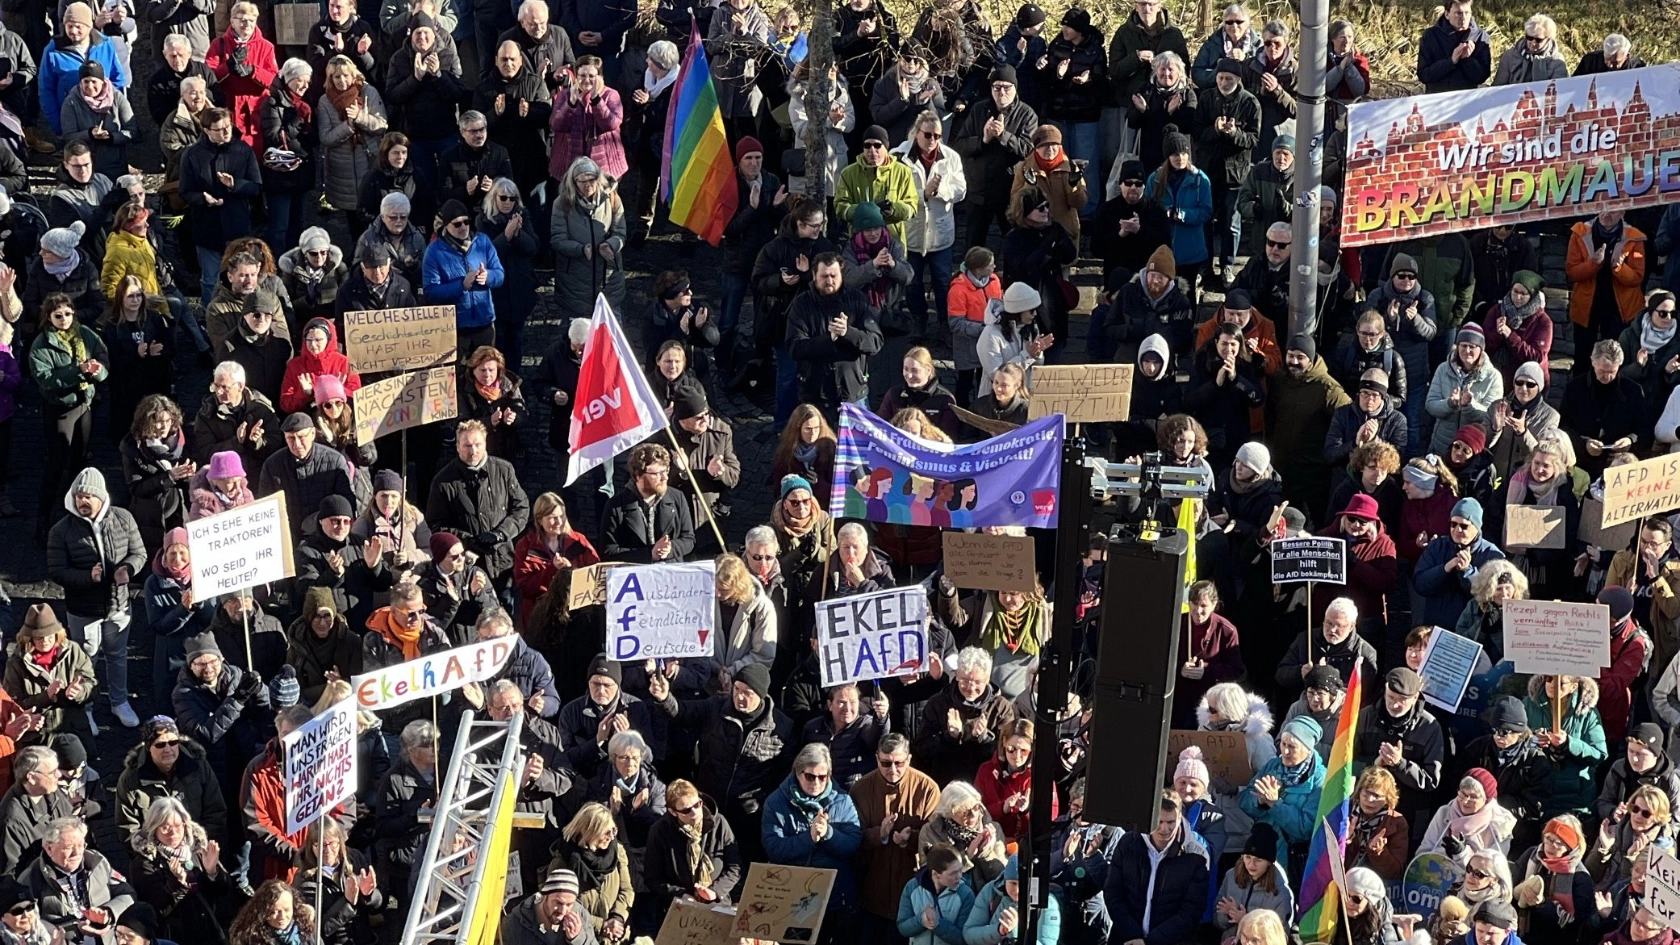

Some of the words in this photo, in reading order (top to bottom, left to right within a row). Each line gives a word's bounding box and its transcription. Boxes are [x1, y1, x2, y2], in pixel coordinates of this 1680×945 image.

[1438, 140, 1496, 171] Wir
[1499, 130, 1562, 164] sind
[1570, 123, 1618, 154] die
[345, 310, 400, 326] WELCHE
[401, 307, 440, 321] STELLE
[442, 306, 455, 318] IM
[366, 342, 400, 355] HABT
[406, 338, 431, 350] IHR
[350, 359, 389, 371] NICHT
[356, 383, 382, 402] WER
[384, 375, 415, 392] SIND
[420, 369, 445, 381] DIE
[1036, 369, 1067, 389] NIE
[1071, 367, 1130, 387] WIEDER
[1071, 387, 1091, 398] IST
[959, 461, 973, 473] &
[1612, 467, 1648, 489] AFD
[1626, 478, 1674, 500] KEINE
[192, 527, 210, 540] ICH
[248, 508, 276, 524] KEINE
[208, 524, 273, 551] TRAKTOREN!
[983, 541, 997, 549] die
[1281, 541, 1310, 549] Bessere
[1311, 540, 1334, 549] Politik
[201, 564, 219, 578] WO
[223, 557, 246, 572] SEID
[255, 547, 273, 560] IHR
[1273, 551, 1284, 559] für
[1286, 550, 1300, 558] alle
[1301, 549, 1340, 559] Menschen
[1299, 560, 1317, 568] hilft
[826, 592, 922, 640] EKEL
[1505, 602, 1537, 616] Rezept
[1543, 608, 1568, 618] gegen
[290, 728, 316, 758] MAN
[320, 711, 347, 738] WIRD
[291, 749, 314, 775] UNS
[316, 722, 352, 759] FRAGEN
[291, 755, 326, 793] WARUM
[327, 738, 352, 764] HABT
[292, 785, 312, 810] IHR
[315, 755, 352, 795] NICHTS
[295, 778, 345, 823] GETAN?
[1650, 887, 1676, 921] für
